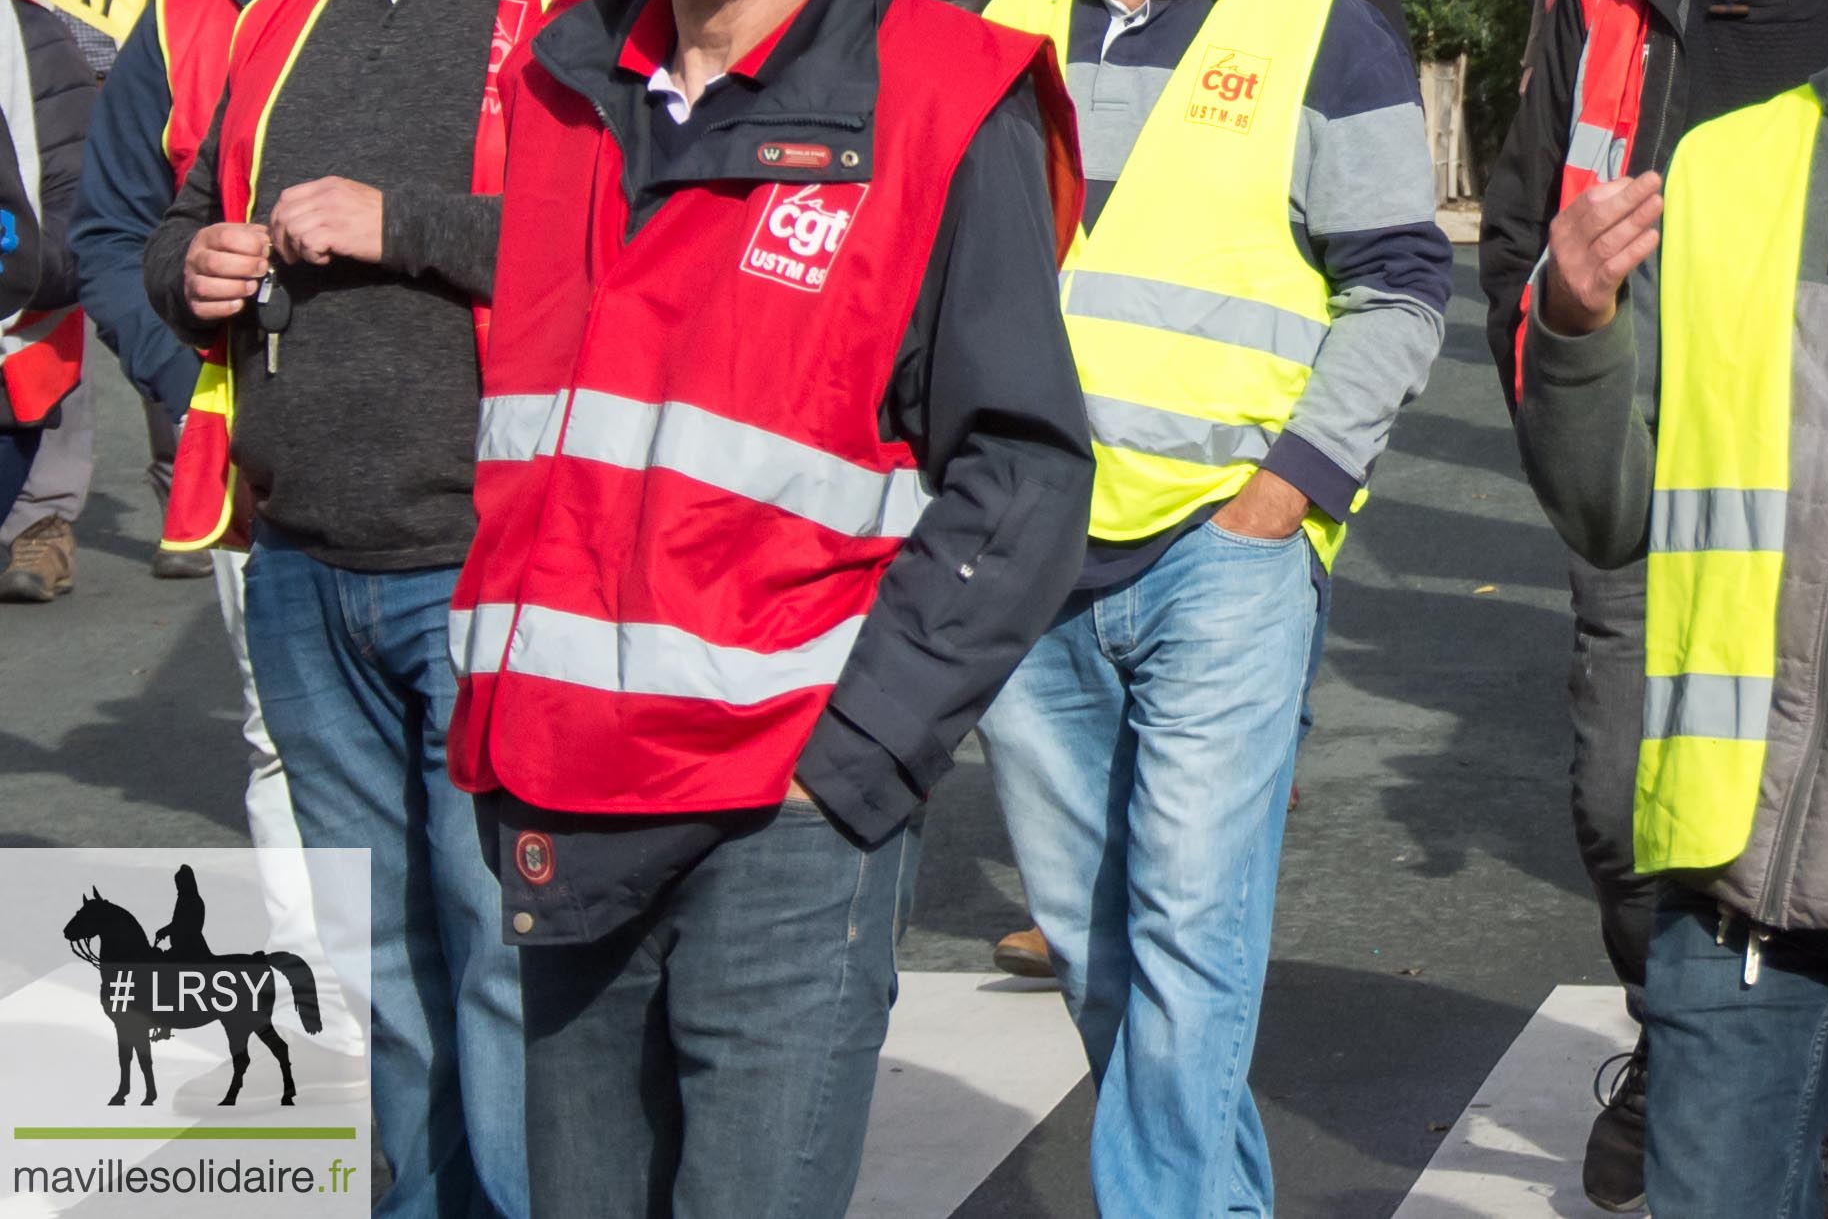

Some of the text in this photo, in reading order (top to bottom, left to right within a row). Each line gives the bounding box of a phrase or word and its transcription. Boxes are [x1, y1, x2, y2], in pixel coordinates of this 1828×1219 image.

[1202, 70, 1258, 101] cgt
[769, 204, 850, 257] cgt
[750, 248, 805, 281] USTM
